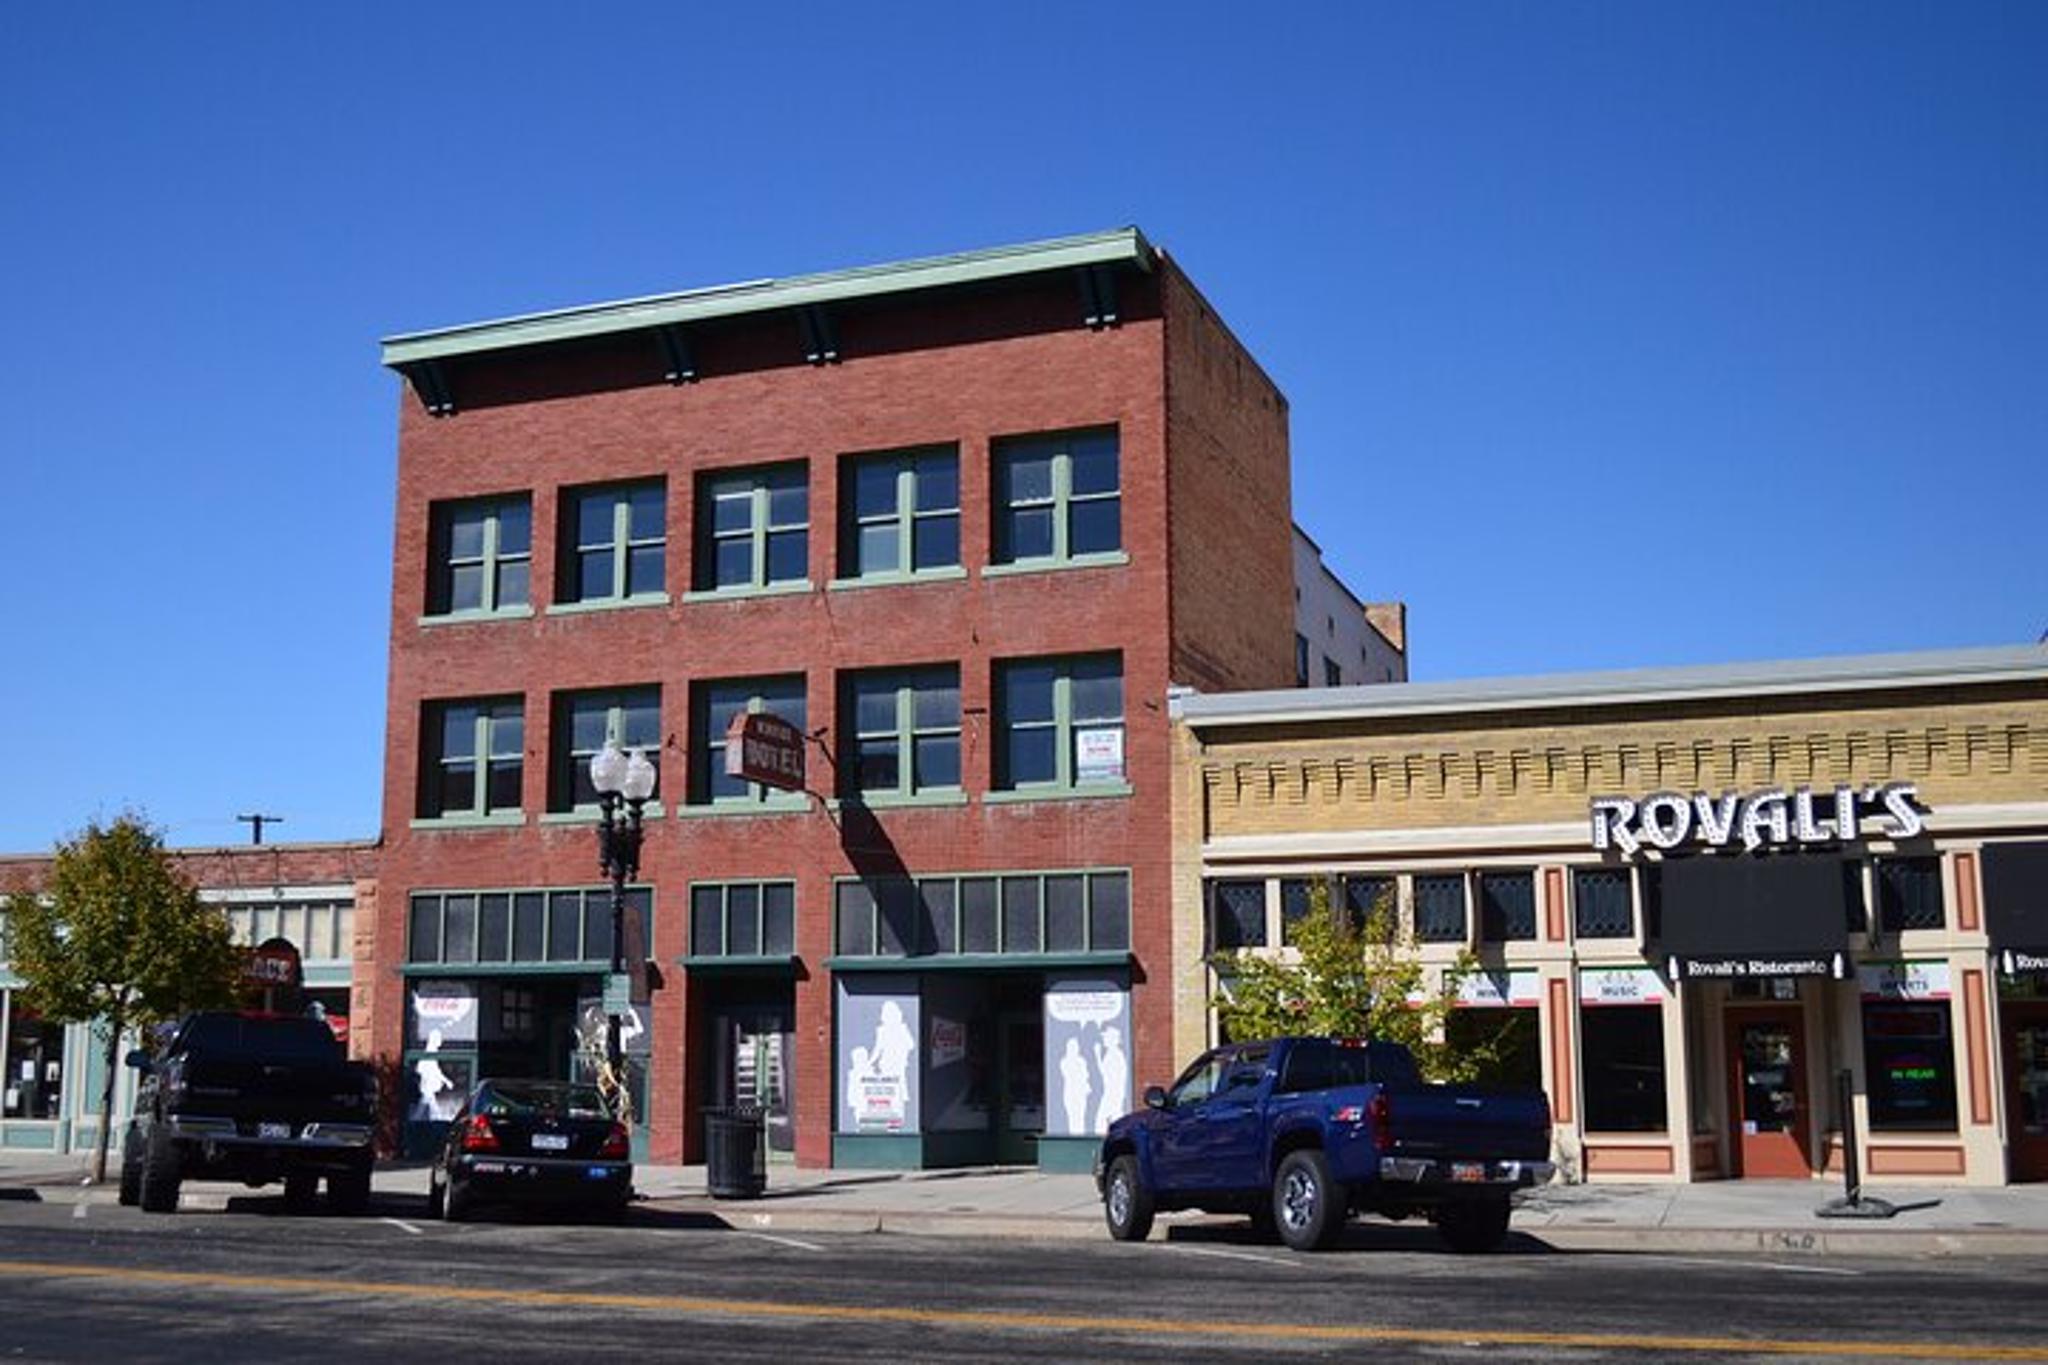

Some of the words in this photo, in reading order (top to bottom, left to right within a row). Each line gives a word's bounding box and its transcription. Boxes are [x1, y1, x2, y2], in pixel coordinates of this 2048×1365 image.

[1592, 783, 1922, 854] ROVALI'S
[1687, 960, 1746, 976] Rovali's
[1905, 1068, 1936, 1079] REAR
